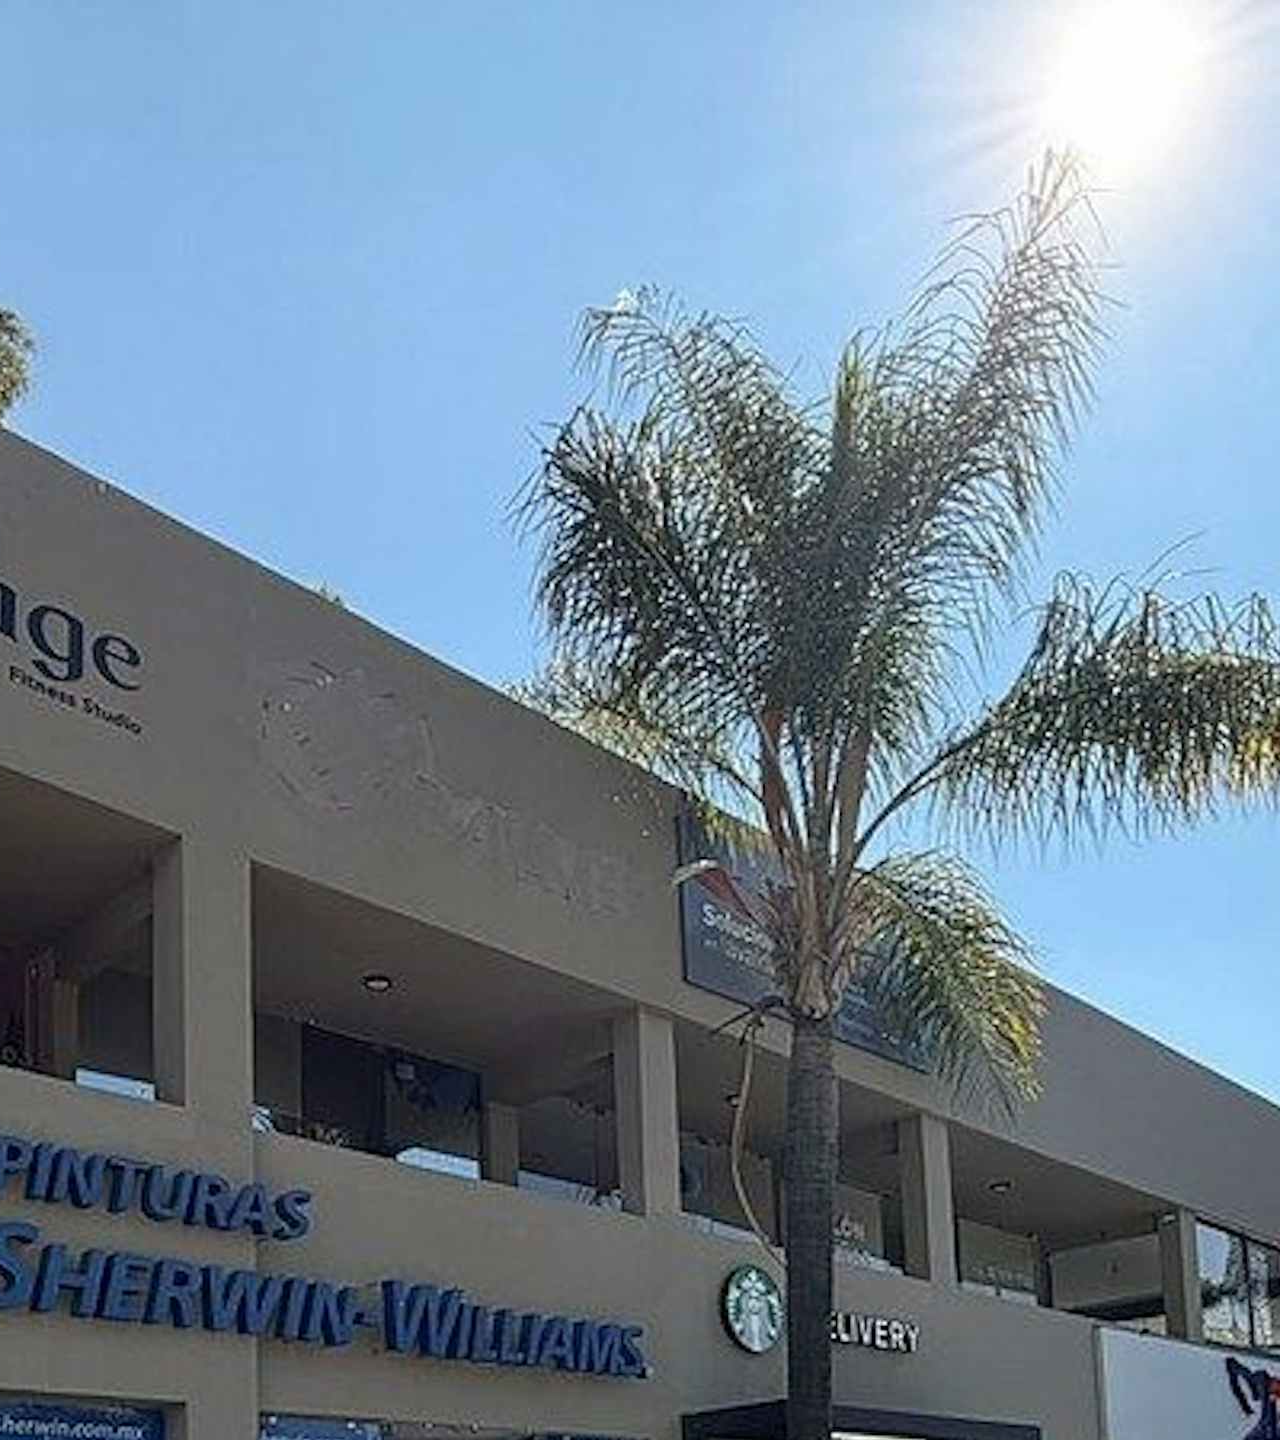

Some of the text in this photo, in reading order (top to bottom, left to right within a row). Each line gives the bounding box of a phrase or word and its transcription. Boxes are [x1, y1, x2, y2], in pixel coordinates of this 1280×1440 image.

[9, 665, 142, 735] Fitness Studio
[830, 1311, 920, 1353] LIVERY
